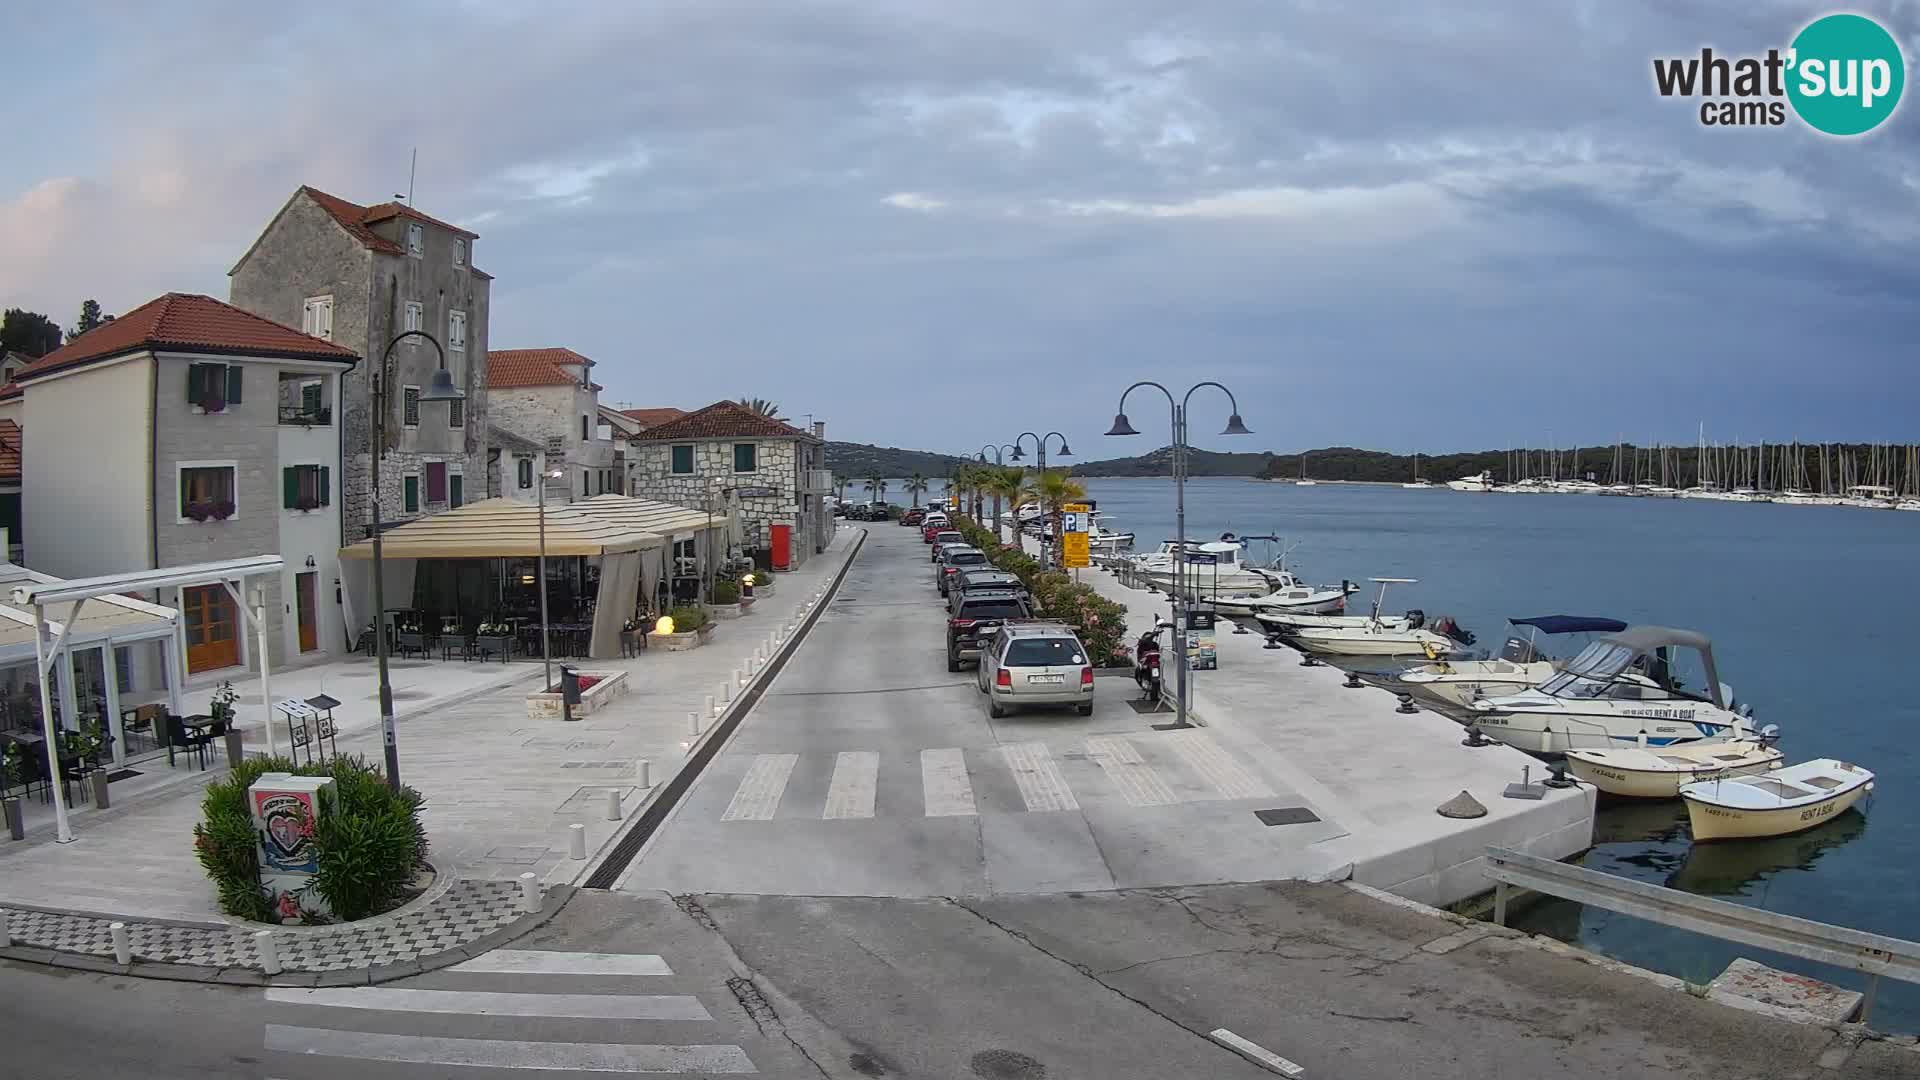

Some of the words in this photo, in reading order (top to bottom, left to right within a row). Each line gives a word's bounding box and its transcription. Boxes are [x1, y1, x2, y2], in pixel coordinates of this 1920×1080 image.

[1065, 514, 1076, 530] P
[1654, 709, 1672, 718] RENT
[1672, 709, 1678, 718] A
[1679, 709, 1696, 720] BOAT
[1800, 807, 1817, 821] RENT
[1821, 801, 1836, 815] BOAT
